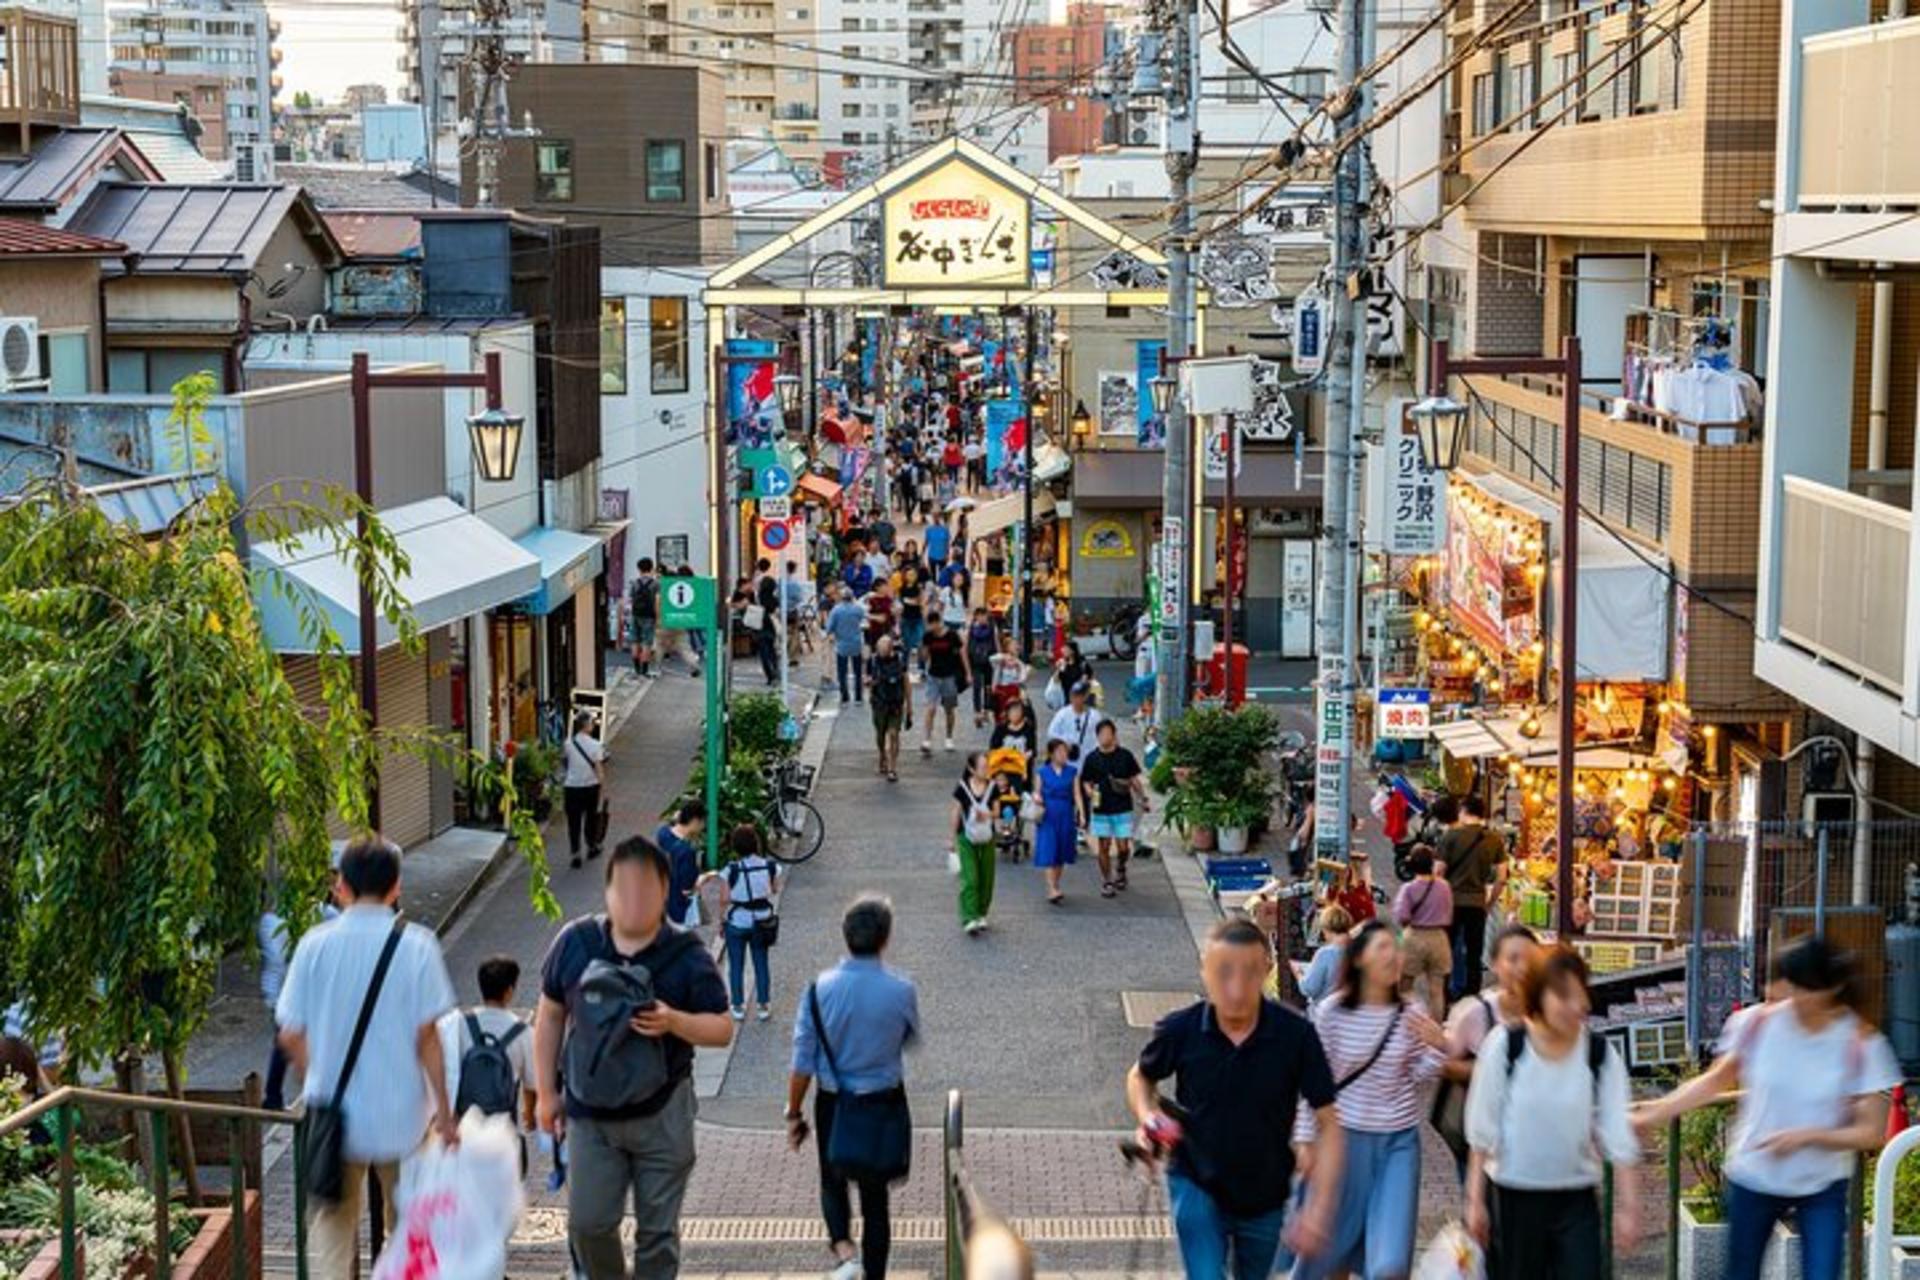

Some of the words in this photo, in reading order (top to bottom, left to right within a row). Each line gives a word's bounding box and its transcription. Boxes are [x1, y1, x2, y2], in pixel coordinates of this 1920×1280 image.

[896, 216, 1016, 274] 谷中ぎんざ
[1397, 439, 1414, 520] クリニック
